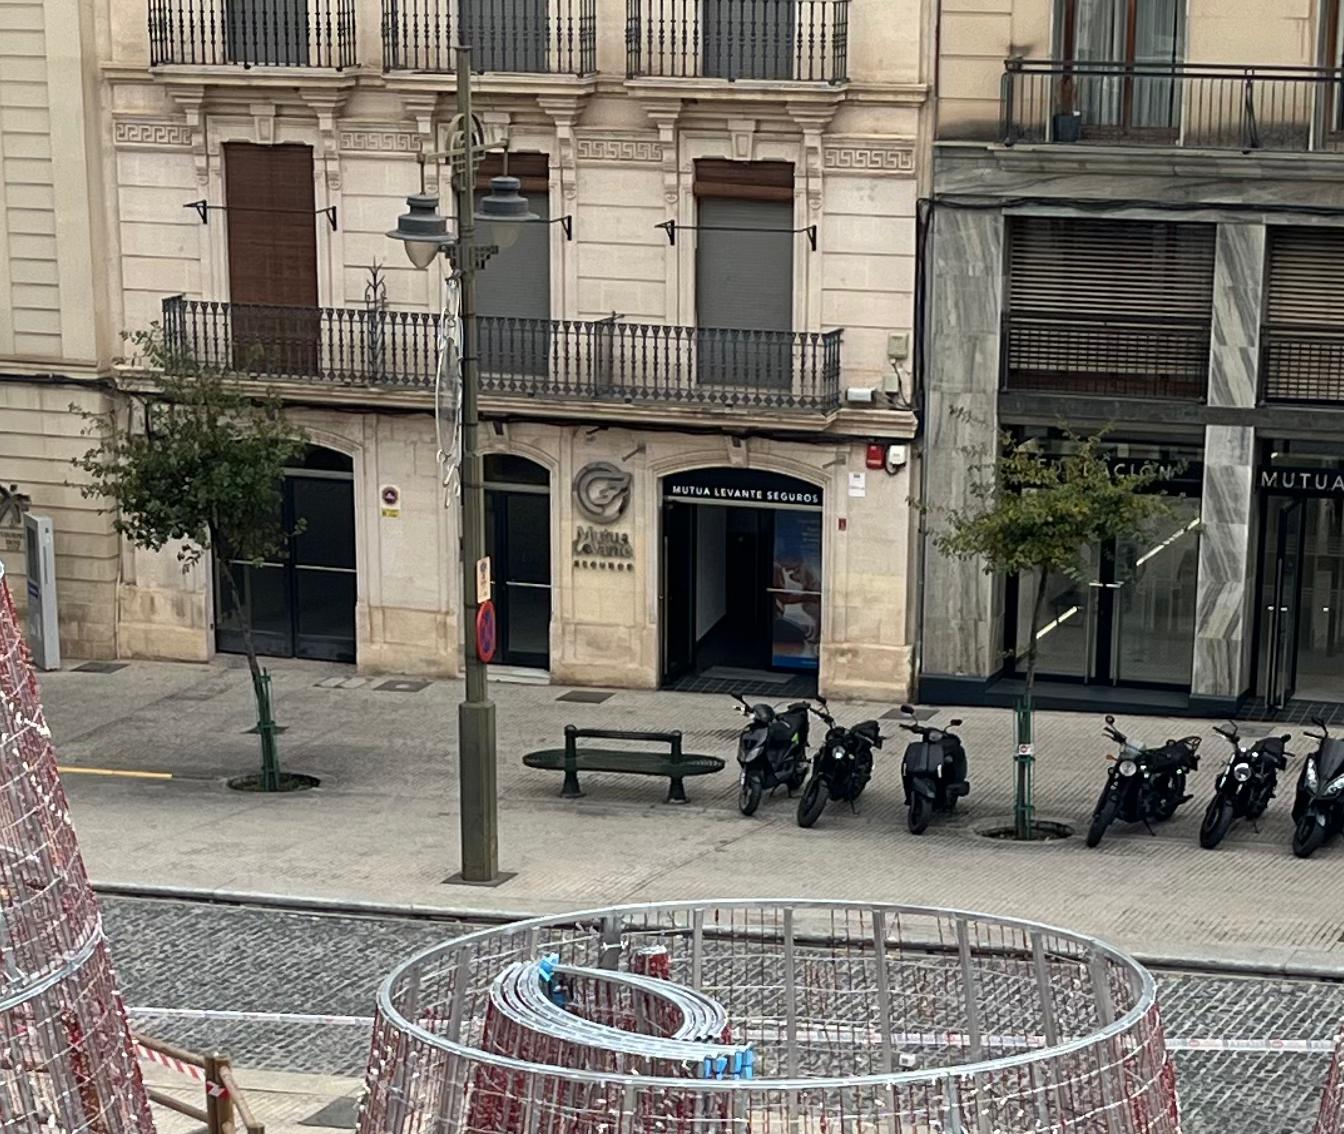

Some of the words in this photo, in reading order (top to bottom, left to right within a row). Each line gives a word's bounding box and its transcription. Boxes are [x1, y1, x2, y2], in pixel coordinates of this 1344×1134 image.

[672, 485, 710, 496] MUTUA
[714, 487, 762, 499] LEVANTE
[767, 491, 818, 503] SEGUROS
